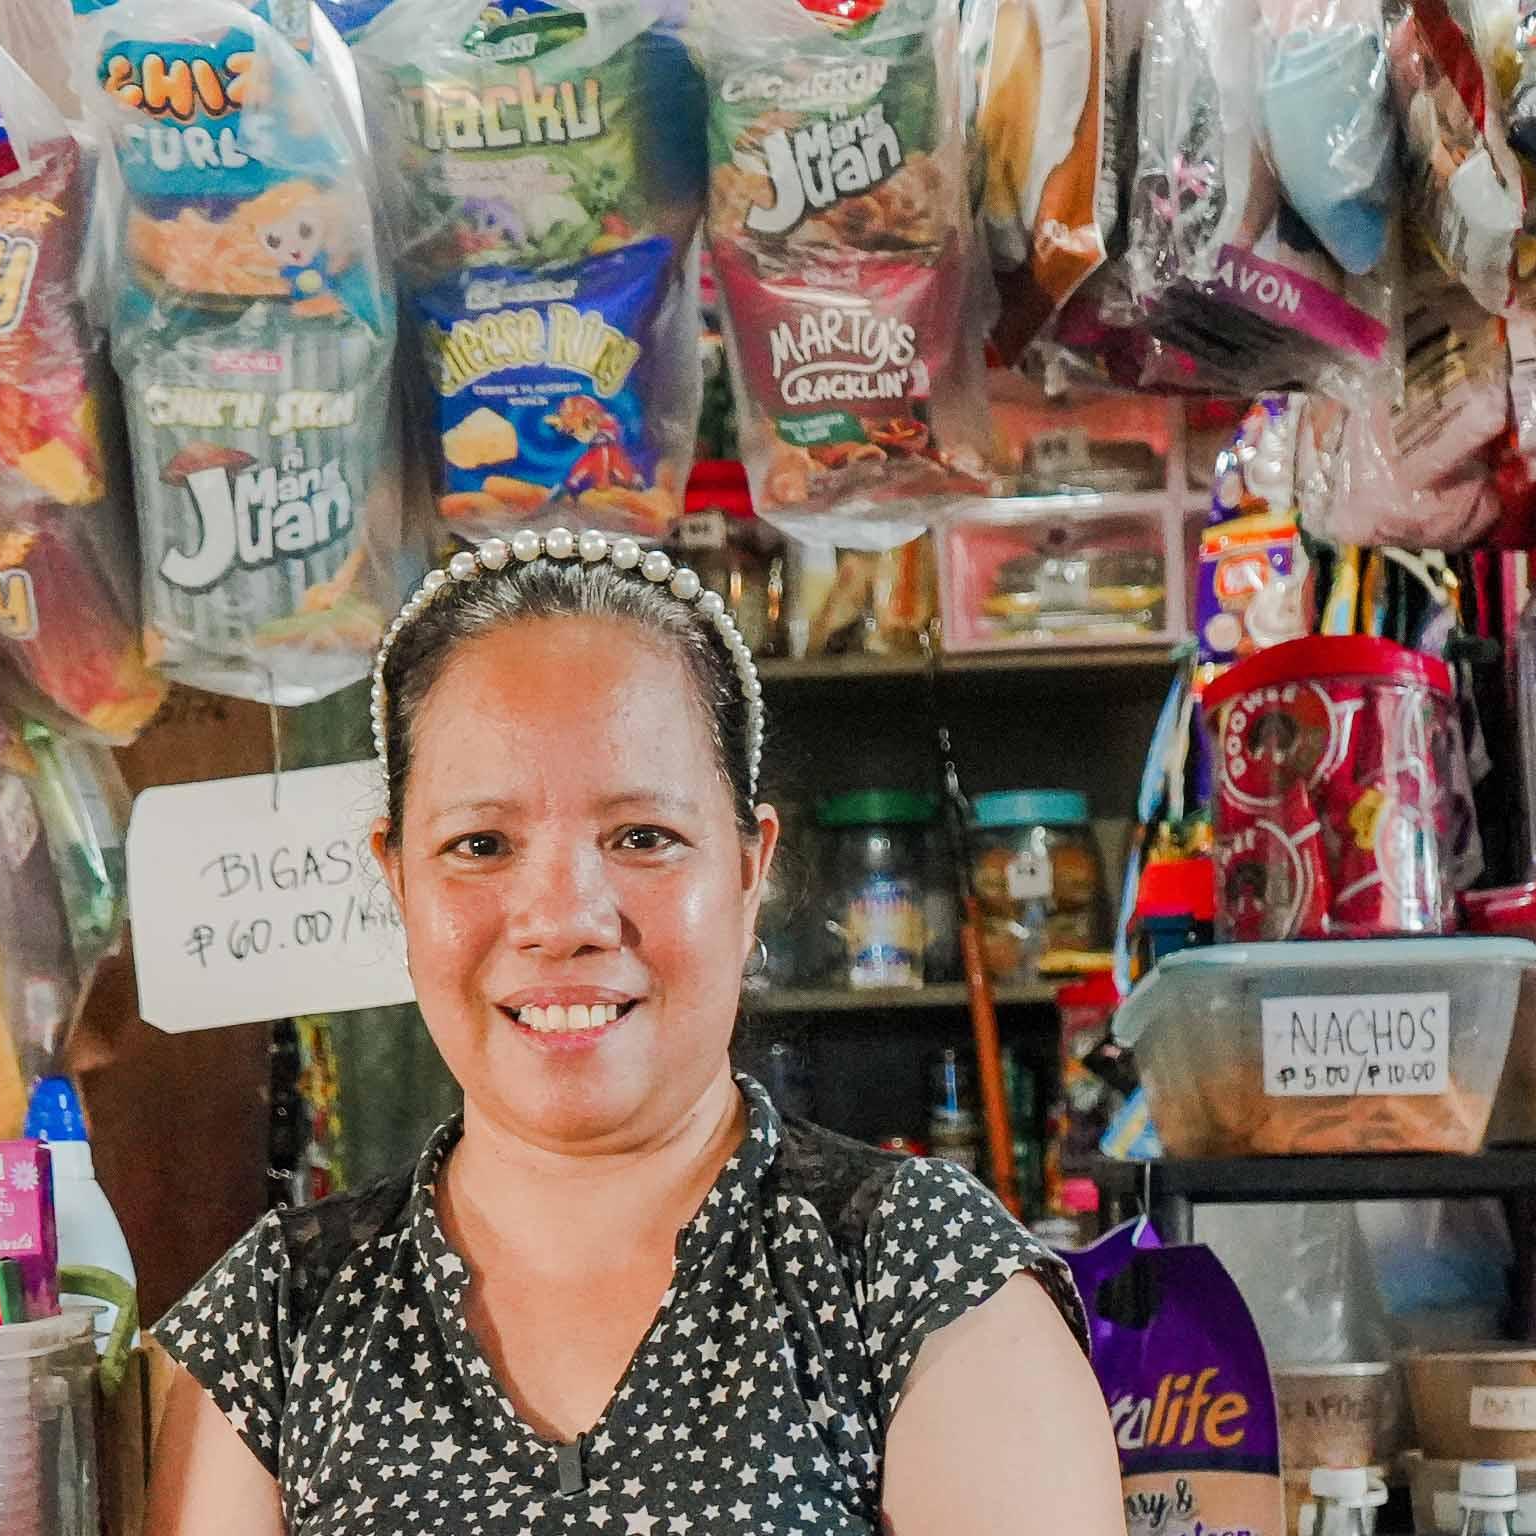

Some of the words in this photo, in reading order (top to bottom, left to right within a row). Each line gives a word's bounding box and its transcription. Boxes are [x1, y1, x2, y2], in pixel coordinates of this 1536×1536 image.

[1217, 260, 1301, 313] AVON
[769, 307, 917, 380] MARTY'S
[200, 840, 354, 898] BIGAS
[1289, 1007, 1438, 1058] NACHOS
